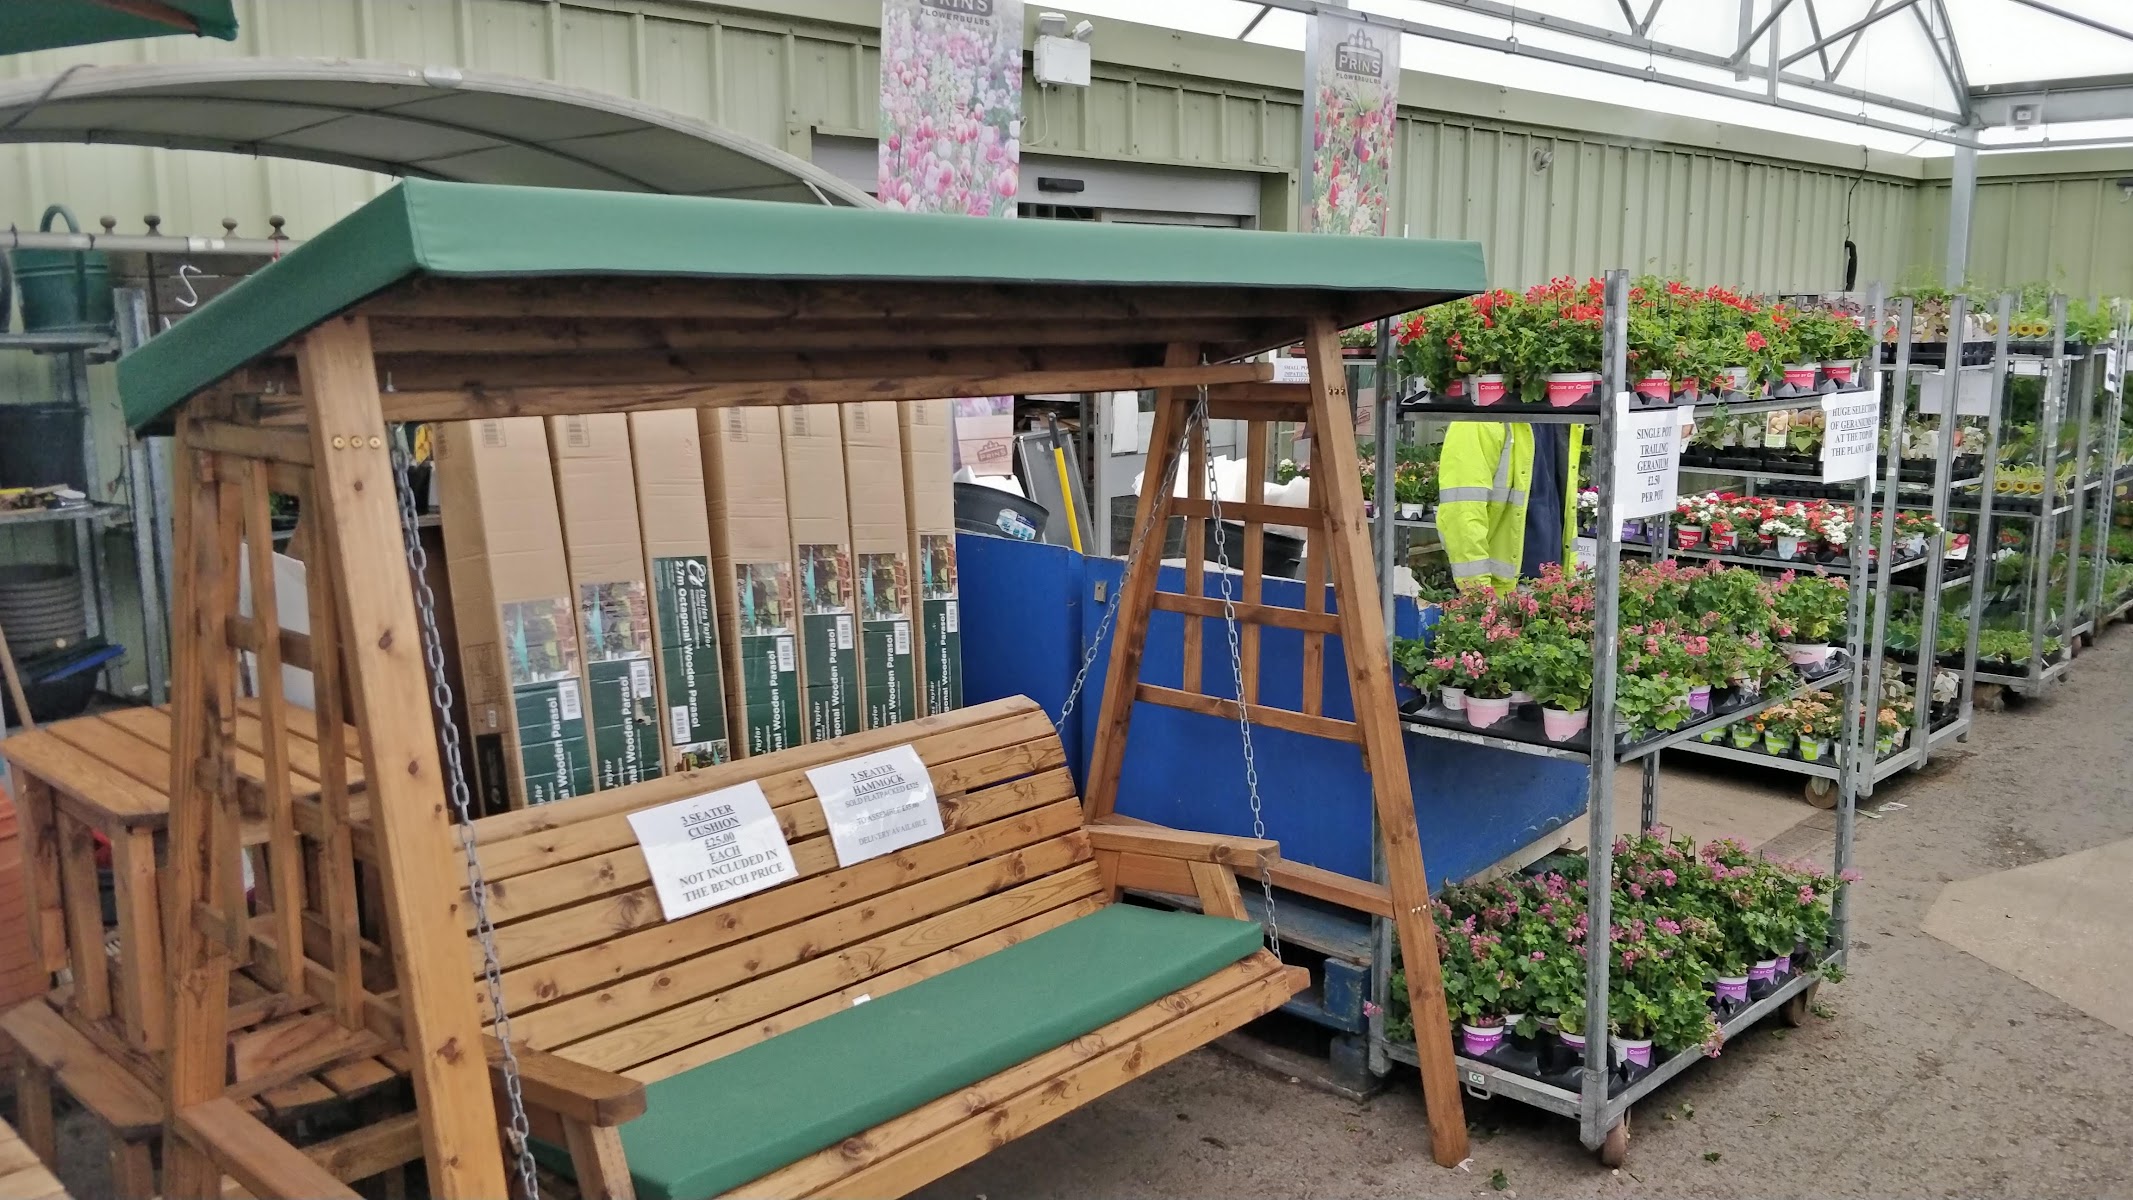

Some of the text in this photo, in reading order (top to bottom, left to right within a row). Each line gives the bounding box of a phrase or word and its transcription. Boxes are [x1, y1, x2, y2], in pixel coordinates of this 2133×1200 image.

[920, 8, 991, 26] FLOWERBULBS
[922, 0, 989, 12] INS
[1339, 54, 1380, 74] PRINS
[1336, 72, 1382, 85] FLOWERBULBS
[1832, 406, 1852, 417] HUGE
[1636, 426, 1672, 440] SINGLE POT
[1830, 420, 1840, 430] OF
[1640, 443, 1668, 455] TRAILING
[1835, 433, 1846, 443] AT
[1847, 432, 1858, 442] THE
[980, 450, 1006, 461] PRINS
[1831, 447, 1846, 457] THE
[1847, 444, 1864, 455] PLANT
[1638, 458, 1668, 472] GERANIUM
[1642, 490, 1664, 503] PER POT
[674, 560, 684, 586] 2.7m
[678, 588, 692, 642] Octagonal
[700, 588, 712, 648] Charles Taylor
[827, 628, 838, 664] Parasol
[886, 634, 894, 668] Parasol
[684, 644, 696, 688] Wooden
[766, 650, 778, 686] Parasol
[940, 648, 948, 686] Wooden
[618, 676, 632, 716] Parasol
[830, 666, 840, 707] Wooden
[888, 670, 896, 710] Wooden
[546, 696, 562, 738] Parasol
[688, 690, 700, 728] Parasol
[771, 688, 782, 731] Wooden
[814, 701, 822, 726] Taylor
[624, 717, 636, 764] Wooden
[754, 726, 763, 753] Taylor
[554, 740, 568, 788] Wooden
[850, 764, 894, 781] 3 SEATER
[845, 796, 863, 808] SOLD
[864, 785, 906, 802] FLATPACKED
[852, 774, 904, 795] HAMMOCK
[680, 804, 734, 825] 3 SEATER
[856, 816, 867, 826] TO
[688, 816, 740, 838] CUSHION
[858, 818, 928, 845] DELIVERY AVAILABLE
[704, 832, 736, 848] £25.00
[709, 845, 741, 863] EACH
[679, 849, 779, 888] NOT INCLUDED IN
[683, 862, 784, 902] THE BENCH PRICE
